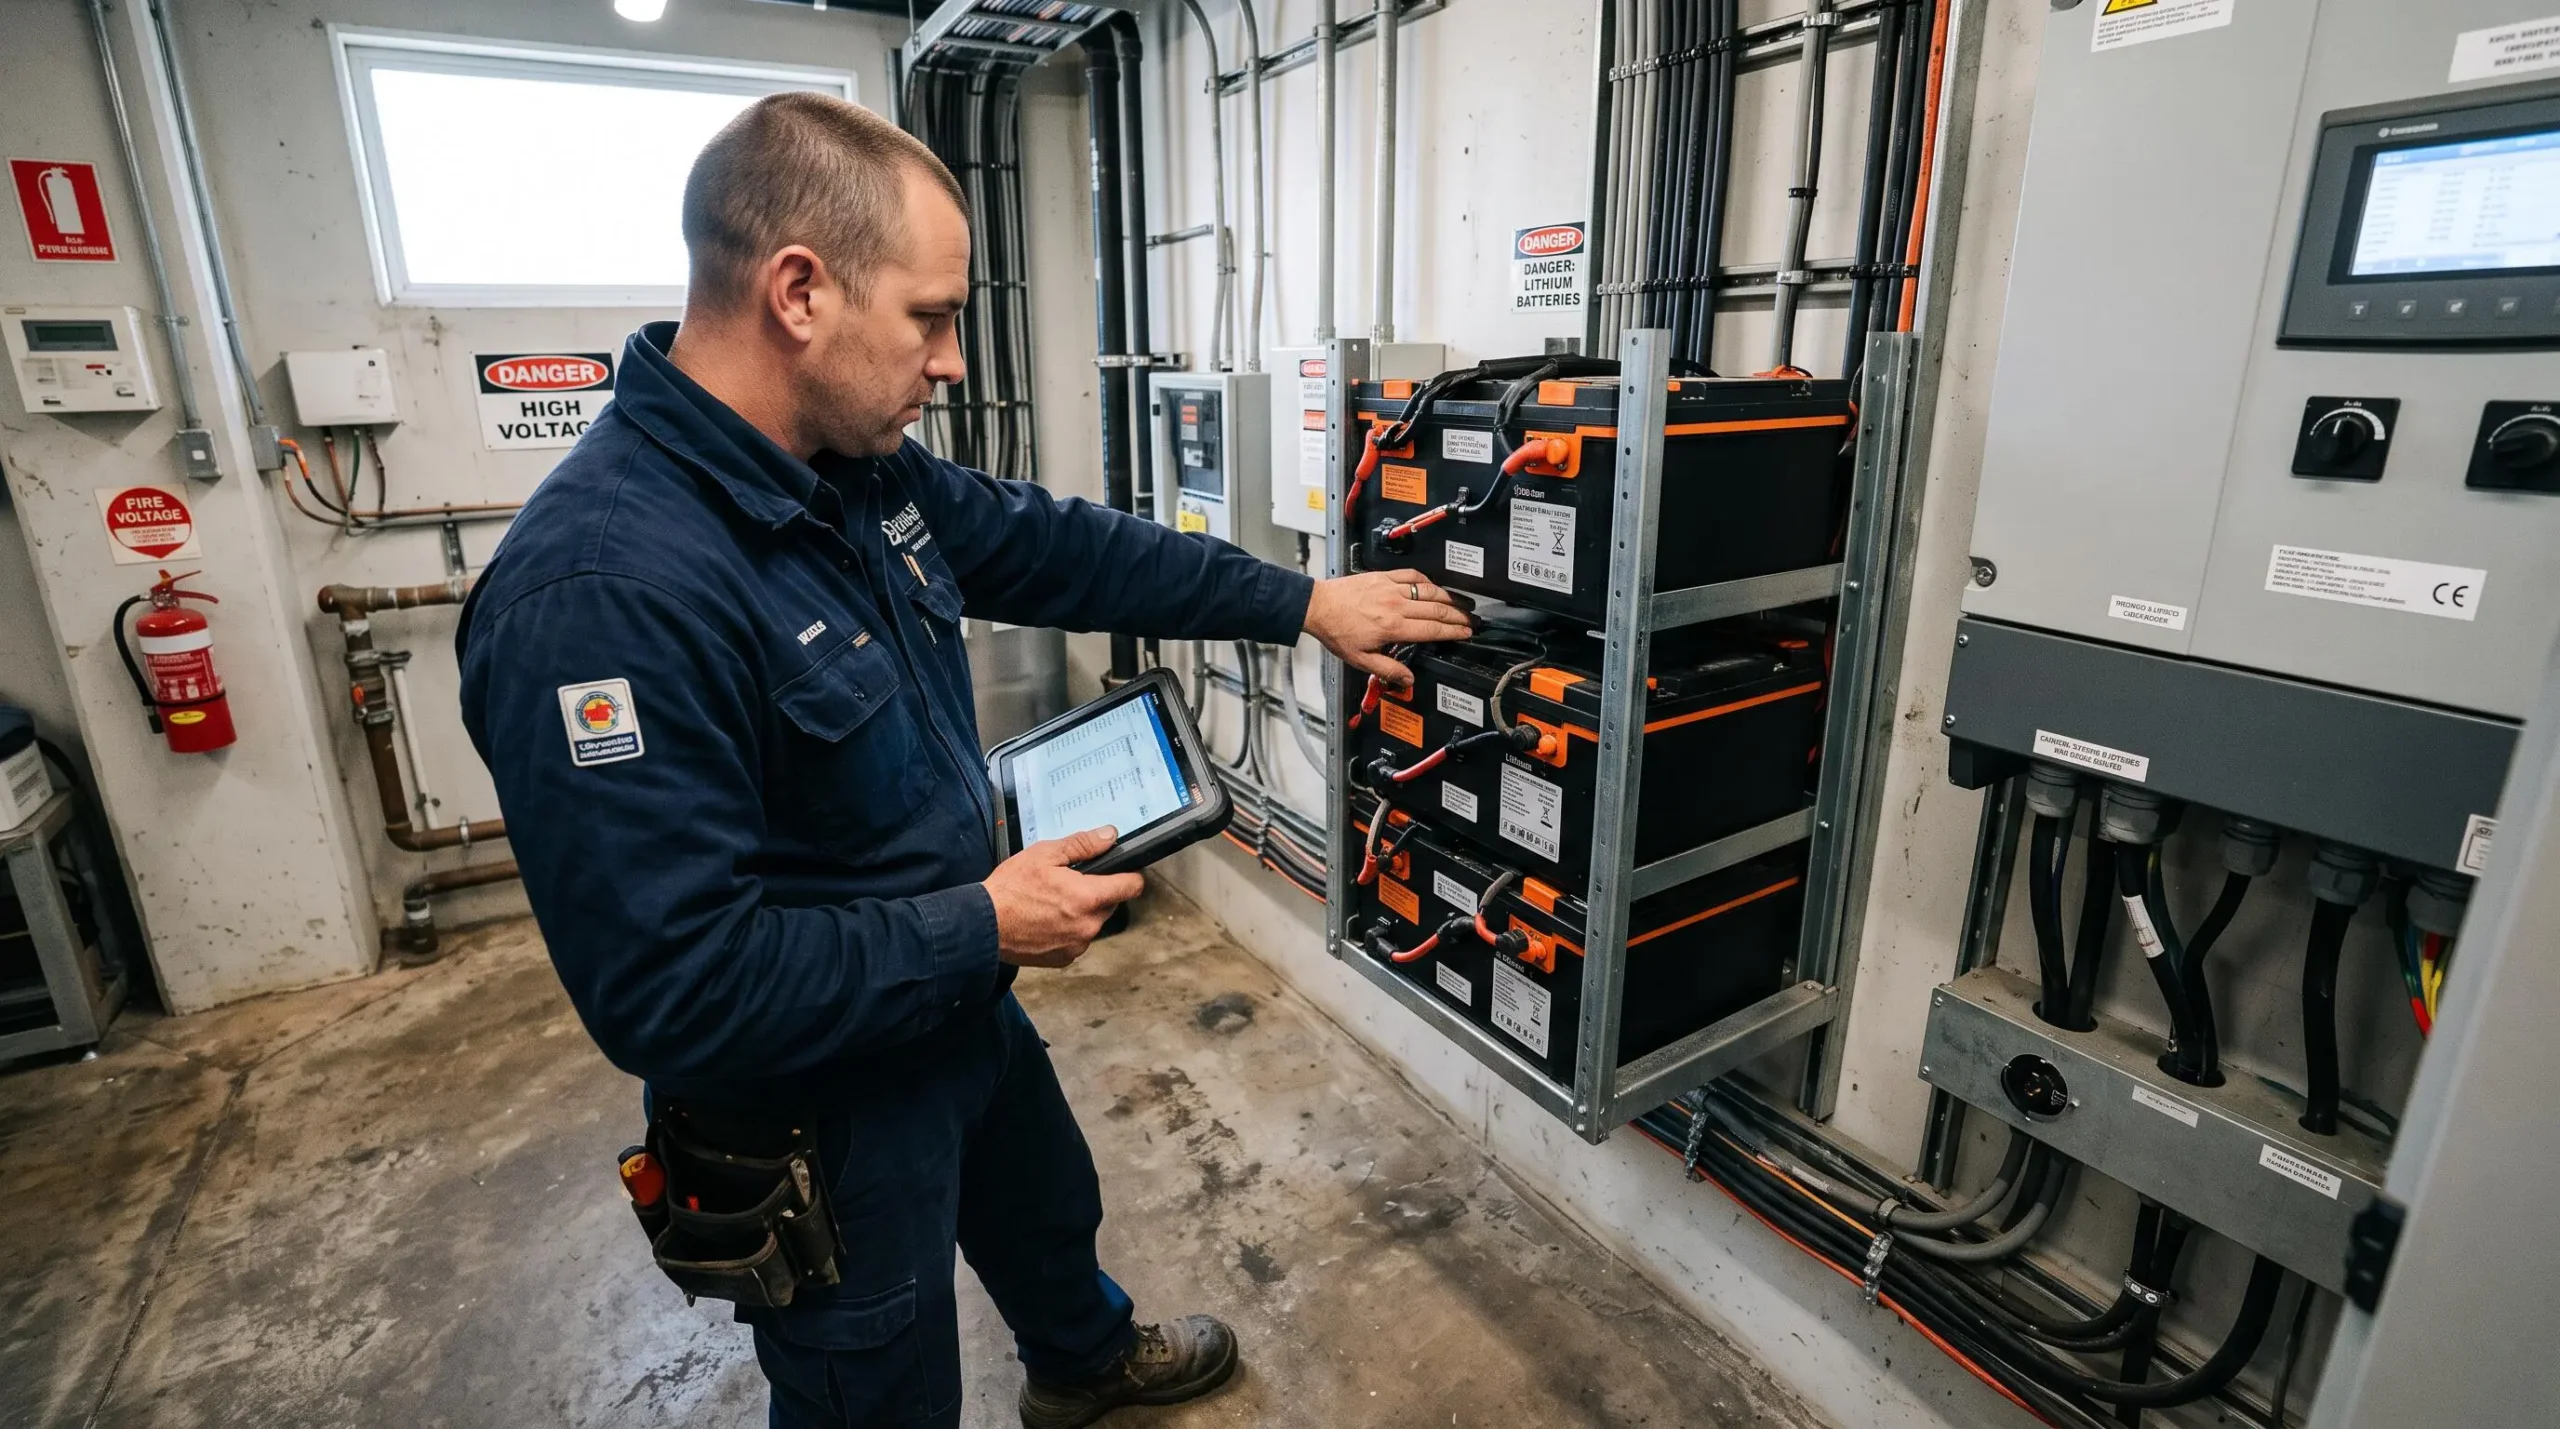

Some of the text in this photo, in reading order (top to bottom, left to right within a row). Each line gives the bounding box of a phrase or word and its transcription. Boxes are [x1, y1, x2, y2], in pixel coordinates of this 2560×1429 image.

[1524, 231, 1576, 251] DANGER
[1524, 259, 1575, 275] DANGER:
[1524, 276, 1572, 291] LITHIUM
[1517, 292, 1581, 308] BATTERIES
[497, 363, 597, 384] DANGER
[520, 400, 581, 417] HIGH
[125, 496, 165, 510] FIRE
[115, 508, 183, 524] VOLTAGE
